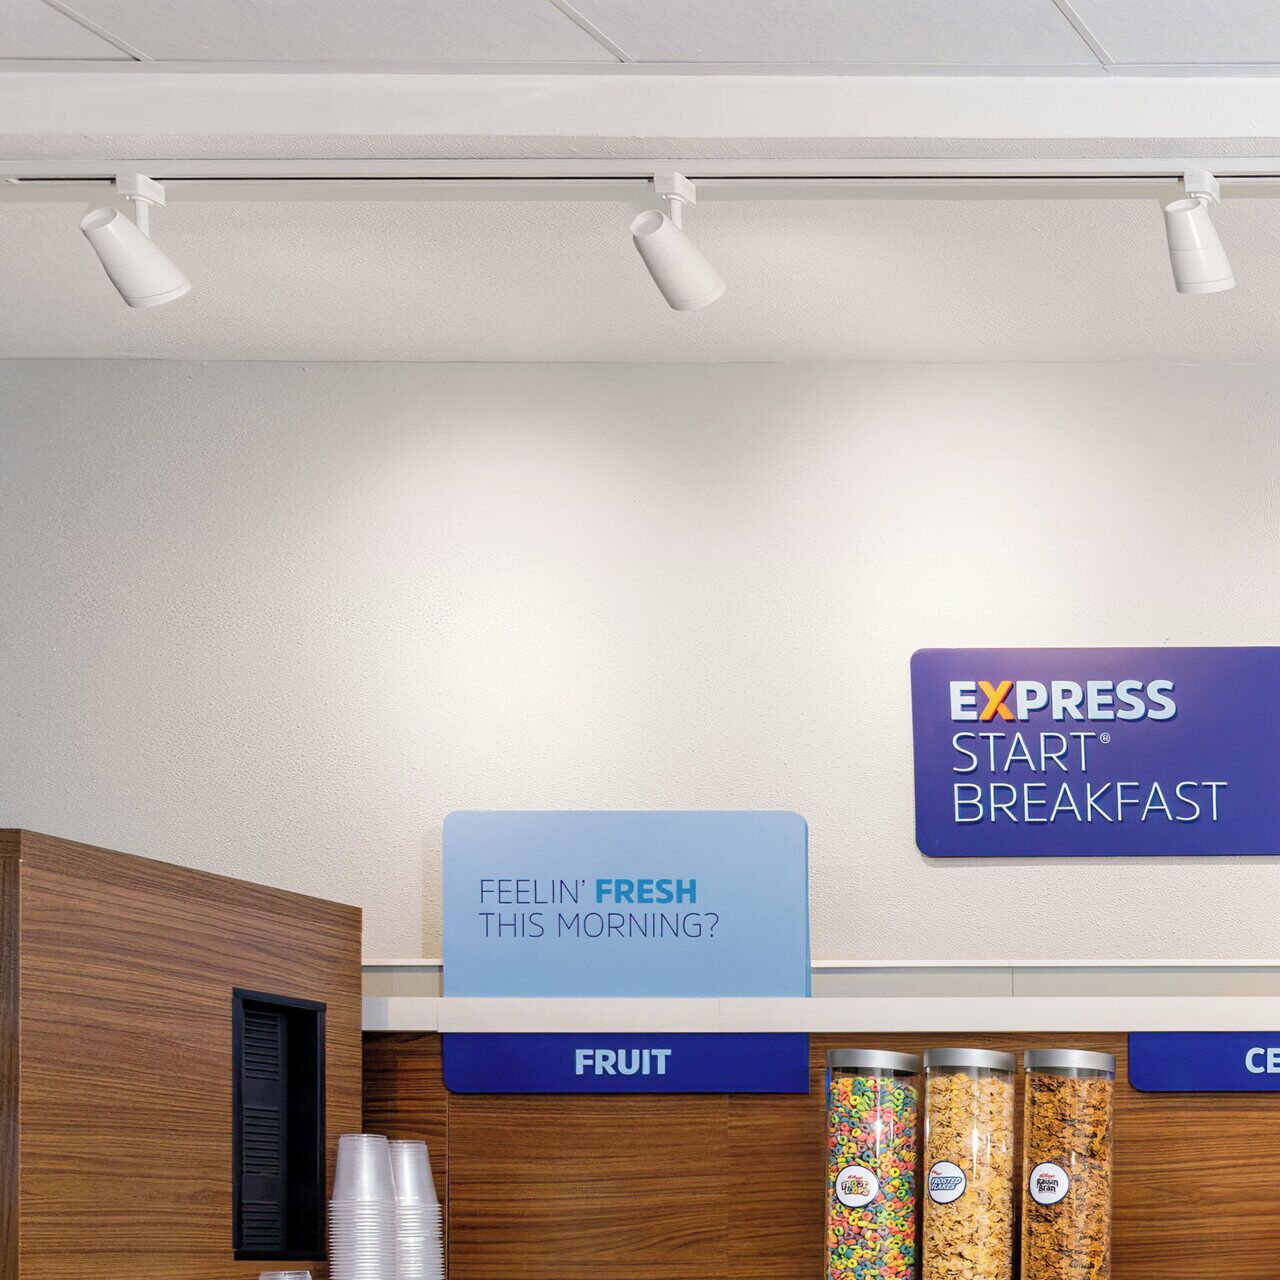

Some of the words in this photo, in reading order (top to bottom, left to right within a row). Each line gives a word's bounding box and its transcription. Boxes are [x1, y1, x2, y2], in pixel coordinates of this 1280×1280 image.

[950, 680, 1177, 721] EXPRESS
[954, 782, 1228, 822] BREAKFAST
[595, 879, 697, 904] FRESH
[478, 912, 545, 938] THIS
[557, 912, 720, 938] MORNING?
[575, 1048, 672, 1075] FRUIT
